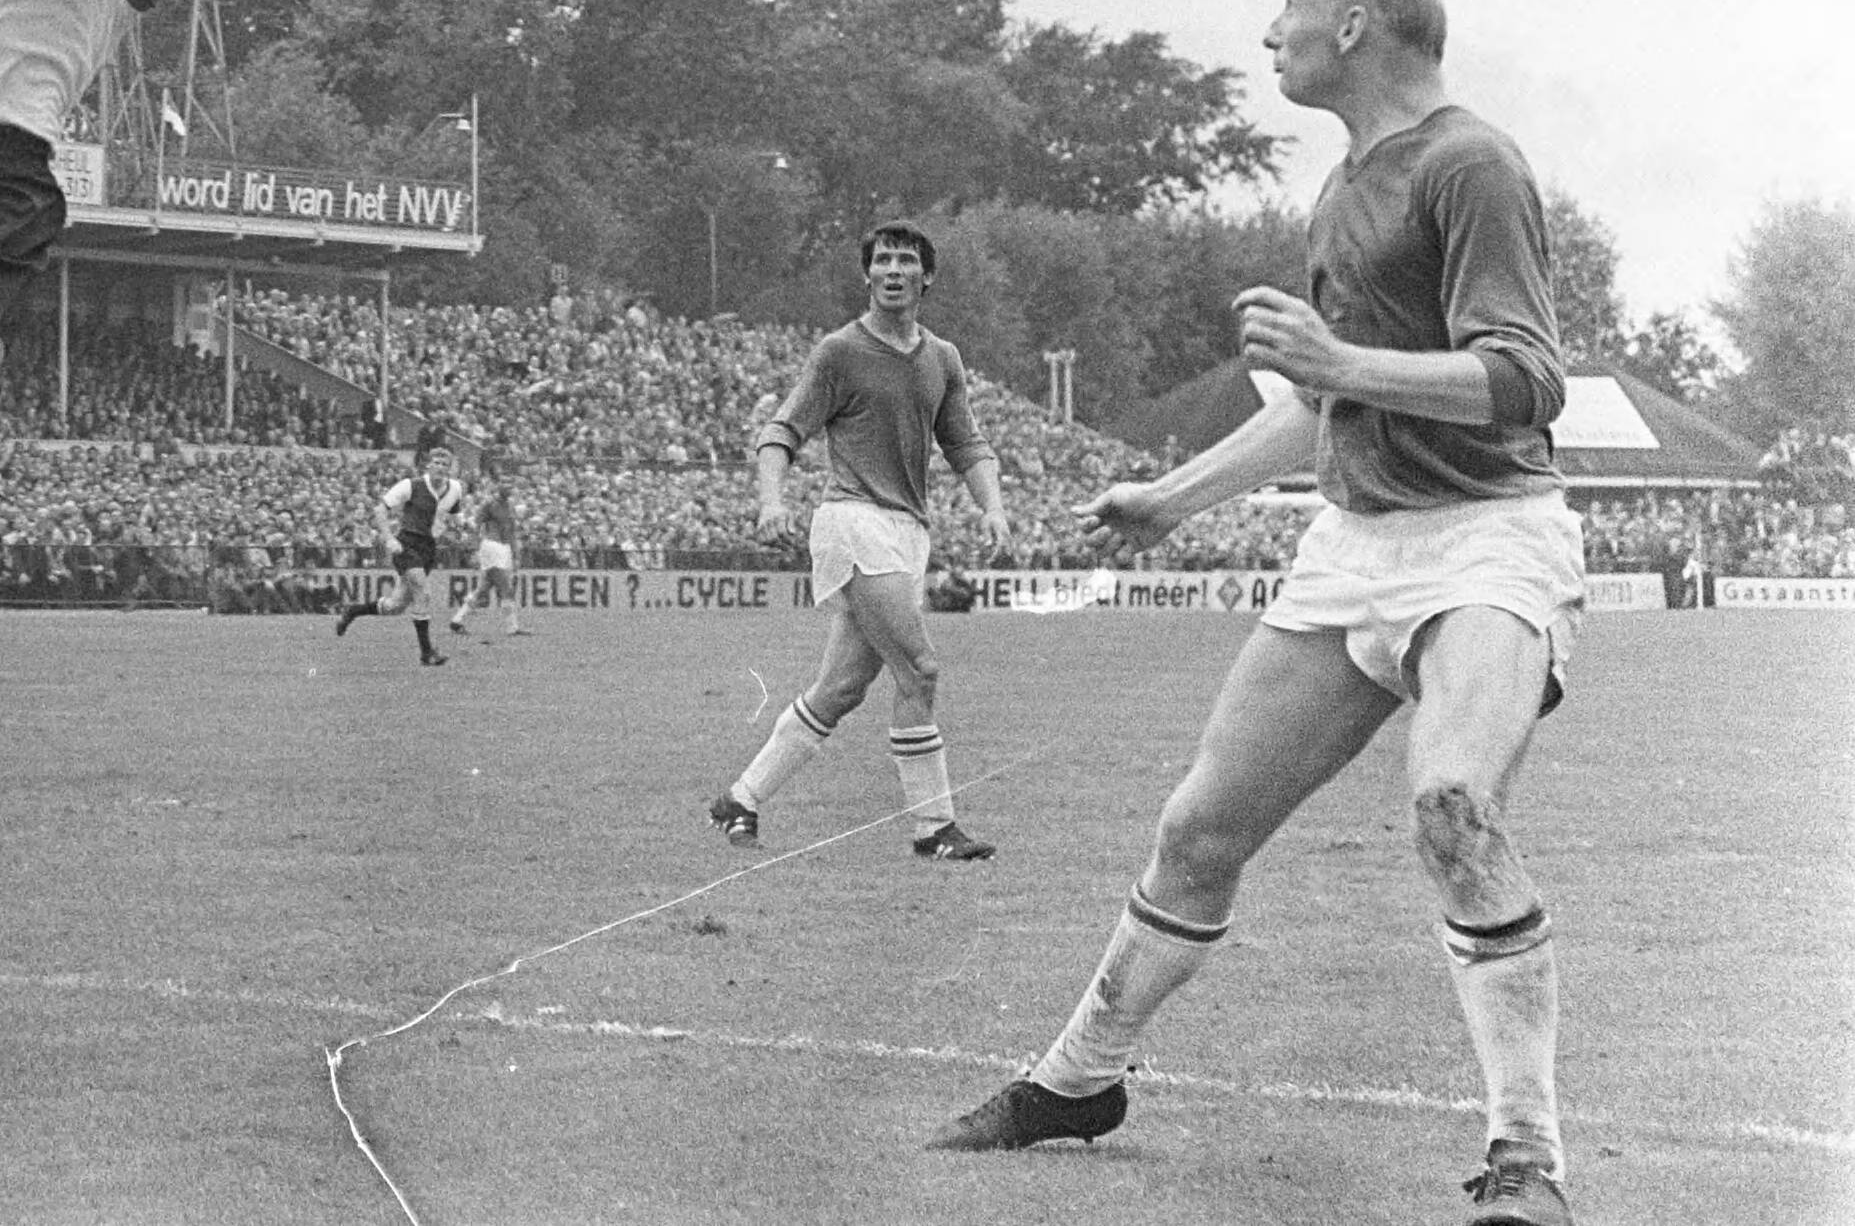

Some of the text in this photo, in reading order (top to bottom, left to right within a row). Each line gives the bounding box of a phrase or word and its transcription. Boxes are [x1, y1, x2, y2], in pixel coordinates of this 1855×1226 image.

[161, 171, 230, 208] word
[243, 173, 276, 212] lid
[286, 185, 334, 216] van
[345, 181, 388, 221] het
[1129, 577, 1208, 609] méér!
